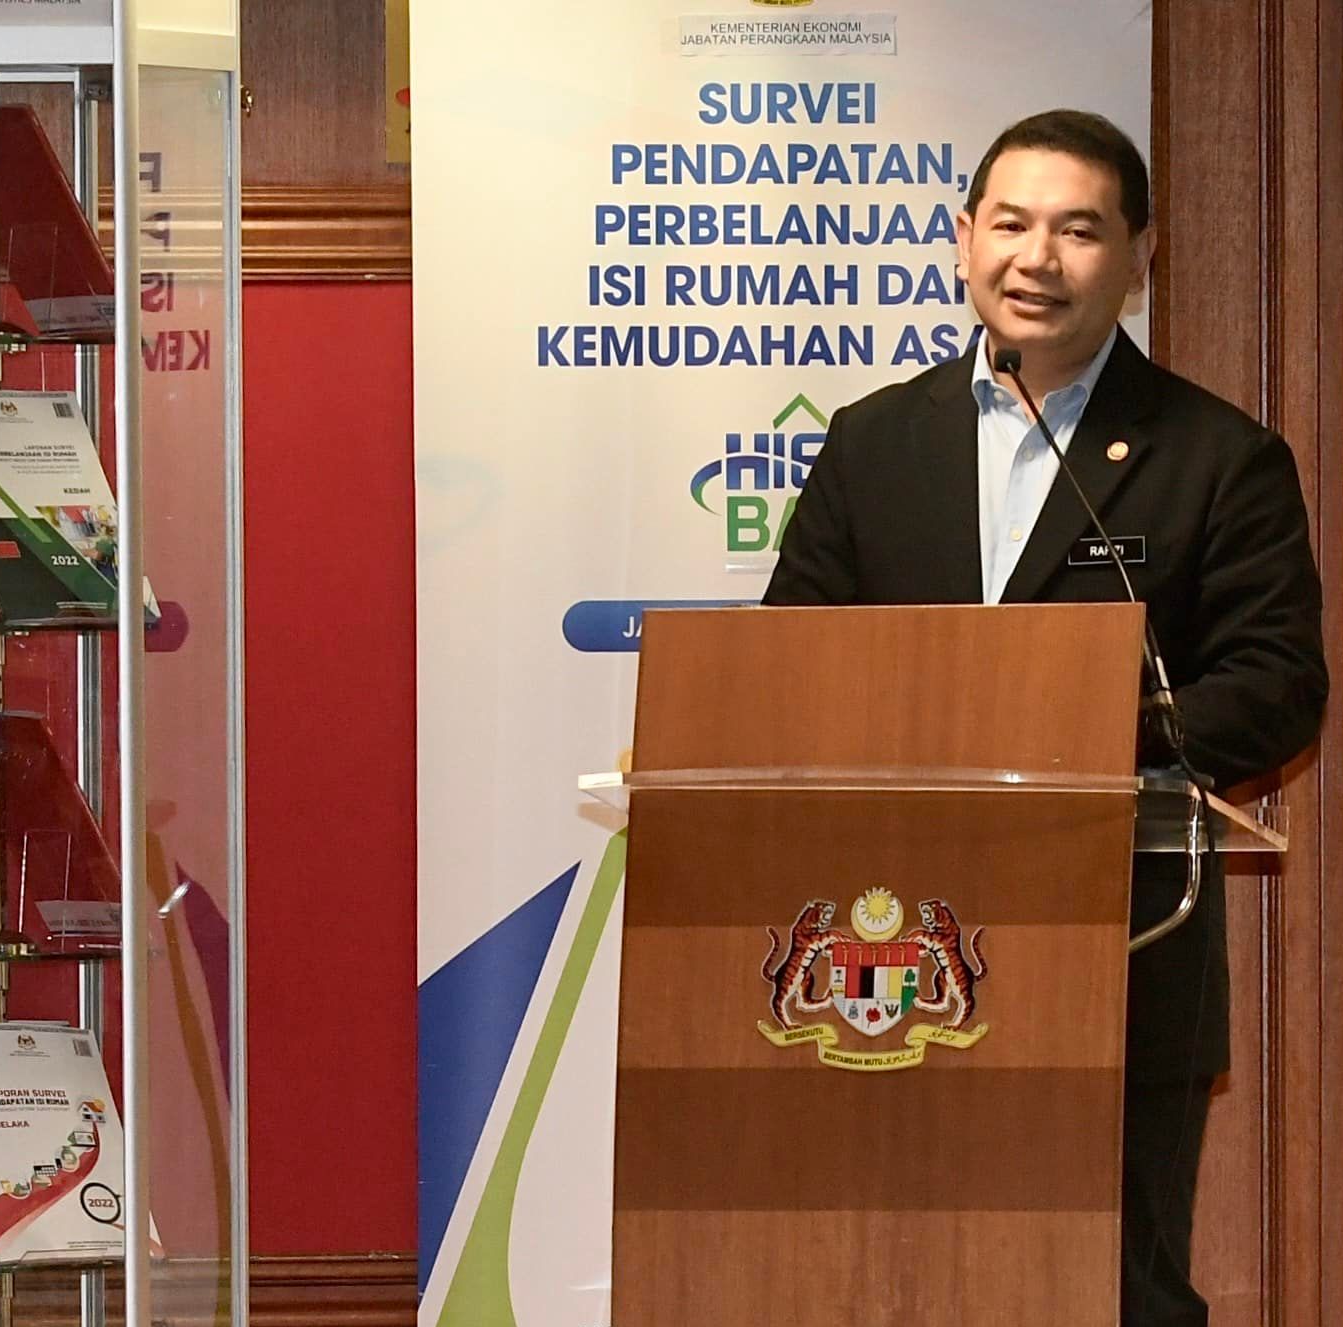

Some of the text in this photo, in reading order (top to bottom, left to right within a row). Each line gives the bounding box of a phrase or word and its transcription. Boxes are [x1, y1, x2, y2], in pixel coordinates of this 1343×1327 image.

[680, 33, 892, 45] JABATAN PERANGKAAN MALAYSIA
[710, 22, 862, 33] KEMENTERIAN EKONOMI
[699, 82, 876, 124] SURVEI
[611, 143, 969, 193] PENDAPATAN,
[595, 203, 970, 246] PERBELANJAA
[588, 265, 646, 306] ISI
[665, 265, 859, 306] RUMAH
[537, 325, 874, 367] KEMUDAHAN
[50, 555, 80, 566] 2022
[32, 1089, 67, 1098] SURVEI
[88, 1198, 115, 1208] 2022
